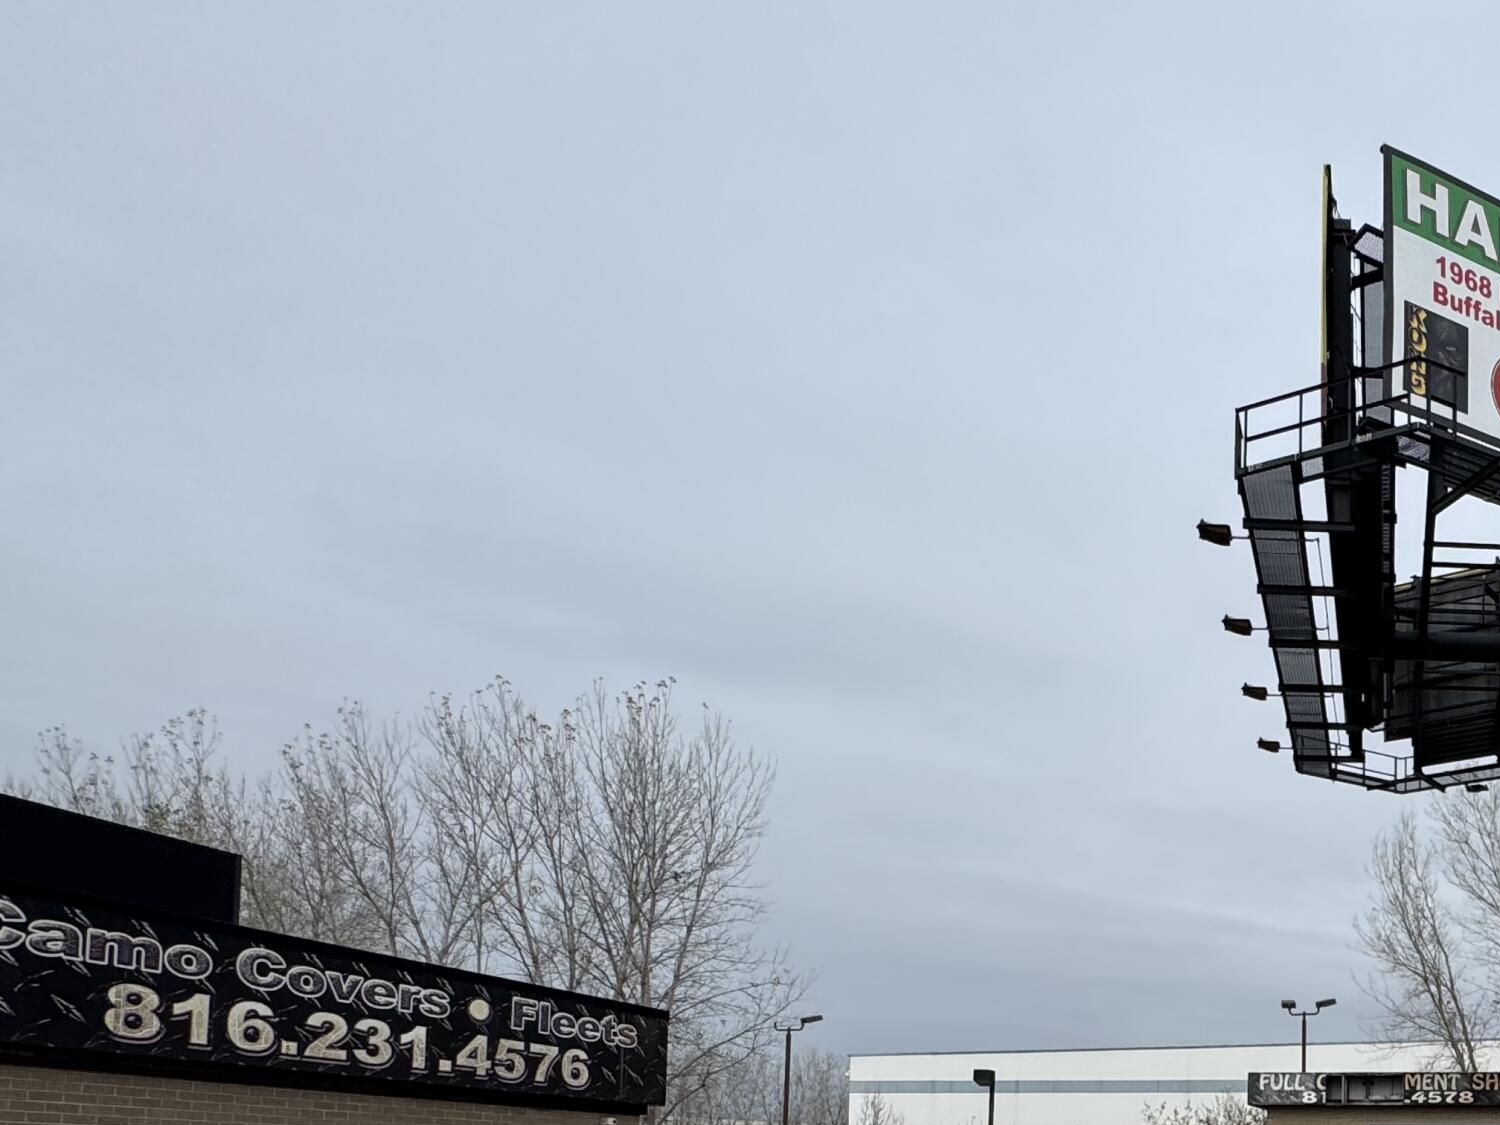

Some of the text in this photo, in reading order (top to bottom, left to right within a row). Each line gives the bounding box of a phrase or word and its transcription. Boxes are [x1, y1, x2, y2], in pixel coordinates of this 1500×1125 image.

[1436, 256, 1493, 299] 1968
[236, 947, 451, 1018] Covers
[510, 996, 638, 1048] Fleets
[103, 982, 592, 1091] 816.231.4576
[1259, 1073, 1306, 1091] FULL
